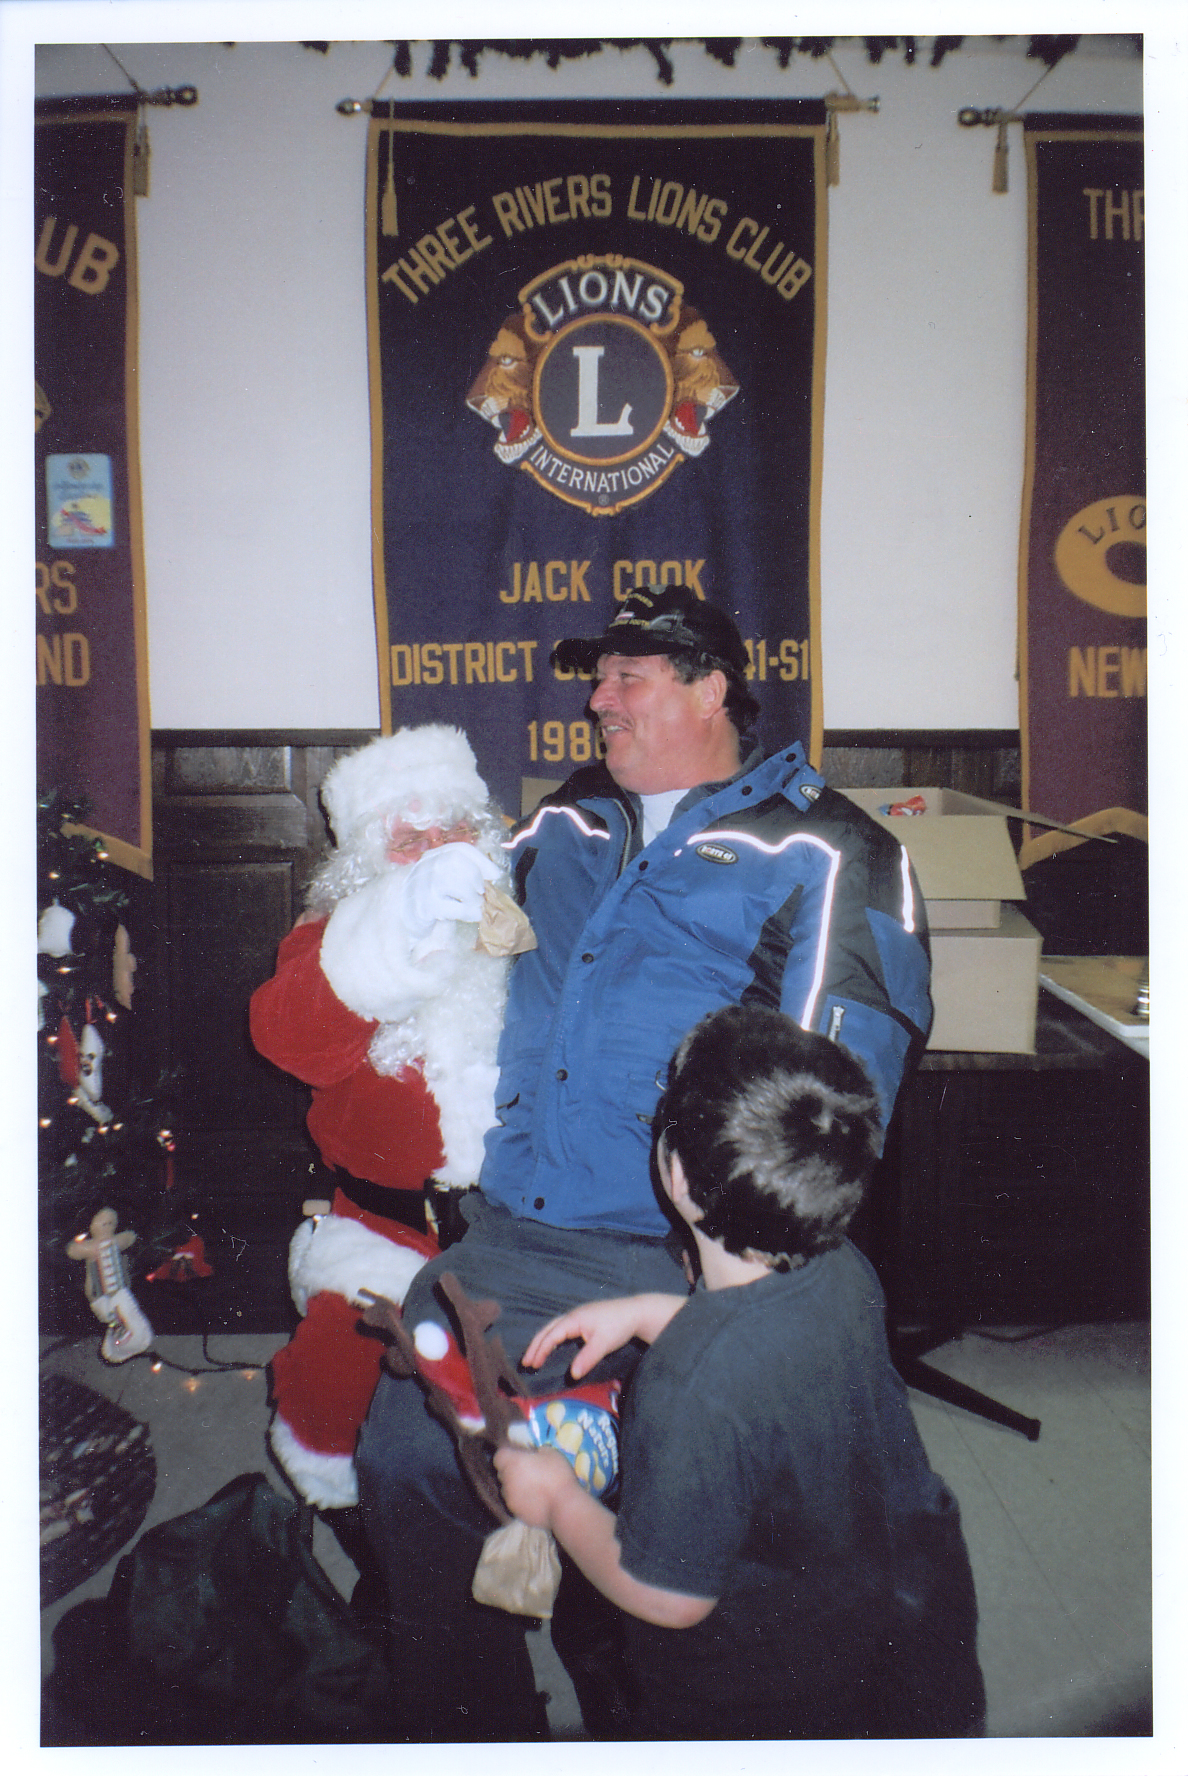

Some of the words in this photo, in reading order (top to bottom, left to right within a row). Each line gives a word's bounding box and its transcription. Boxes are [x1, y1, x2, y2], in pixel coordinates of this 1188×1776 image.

[36, 216, 119, 295] UB
[382, 206, 494, 303] THREE
[492, 174, 613, 238] RIVERS
[627, 175, 729, 244] LIONS
[726, 216, 813, 301] CLUB
[532, 270, 669, 327] LIONS
[570, 345, 633, 437] L
[530, 443, 674, 493] INTERNATIONAL
[500, 560, 592, 603] JACK
[613, 559, 706, 602] COOK
[391, 640, 538, 685] DISTRICT
[577, 1408, 610, 1469] Nature
